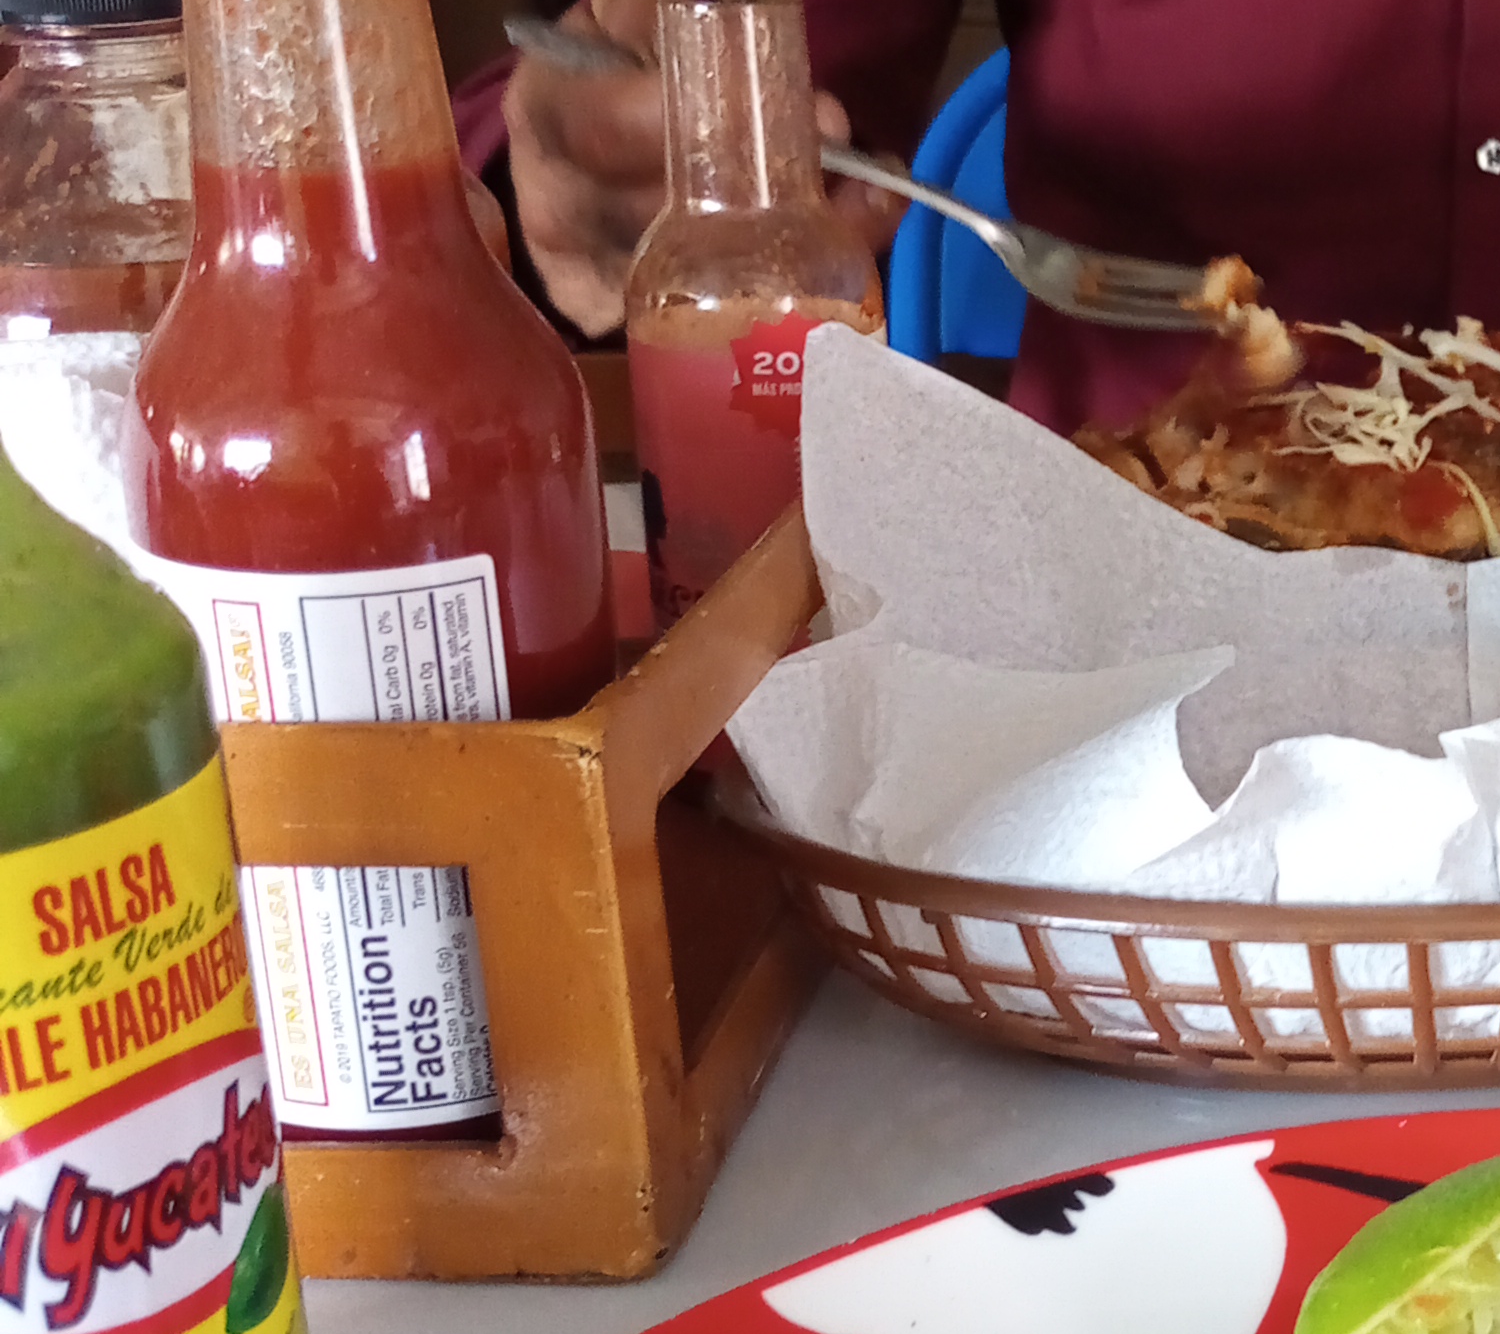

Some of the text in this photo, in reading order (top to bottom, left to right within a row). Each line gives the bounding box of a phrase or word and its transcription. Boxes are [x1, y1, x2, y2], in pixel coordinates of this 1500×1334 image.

[385, 666, 400, 701] Carb
[32, 842, 177, 957] SALSA
[380, 893, 394, 926] Total
[411, 871, 427, 910] Trans
[113, 900, 207, 975] Verde
[358, 935, 409, 1107] Nutrition
[404, 995, 448, 1104] Facts
